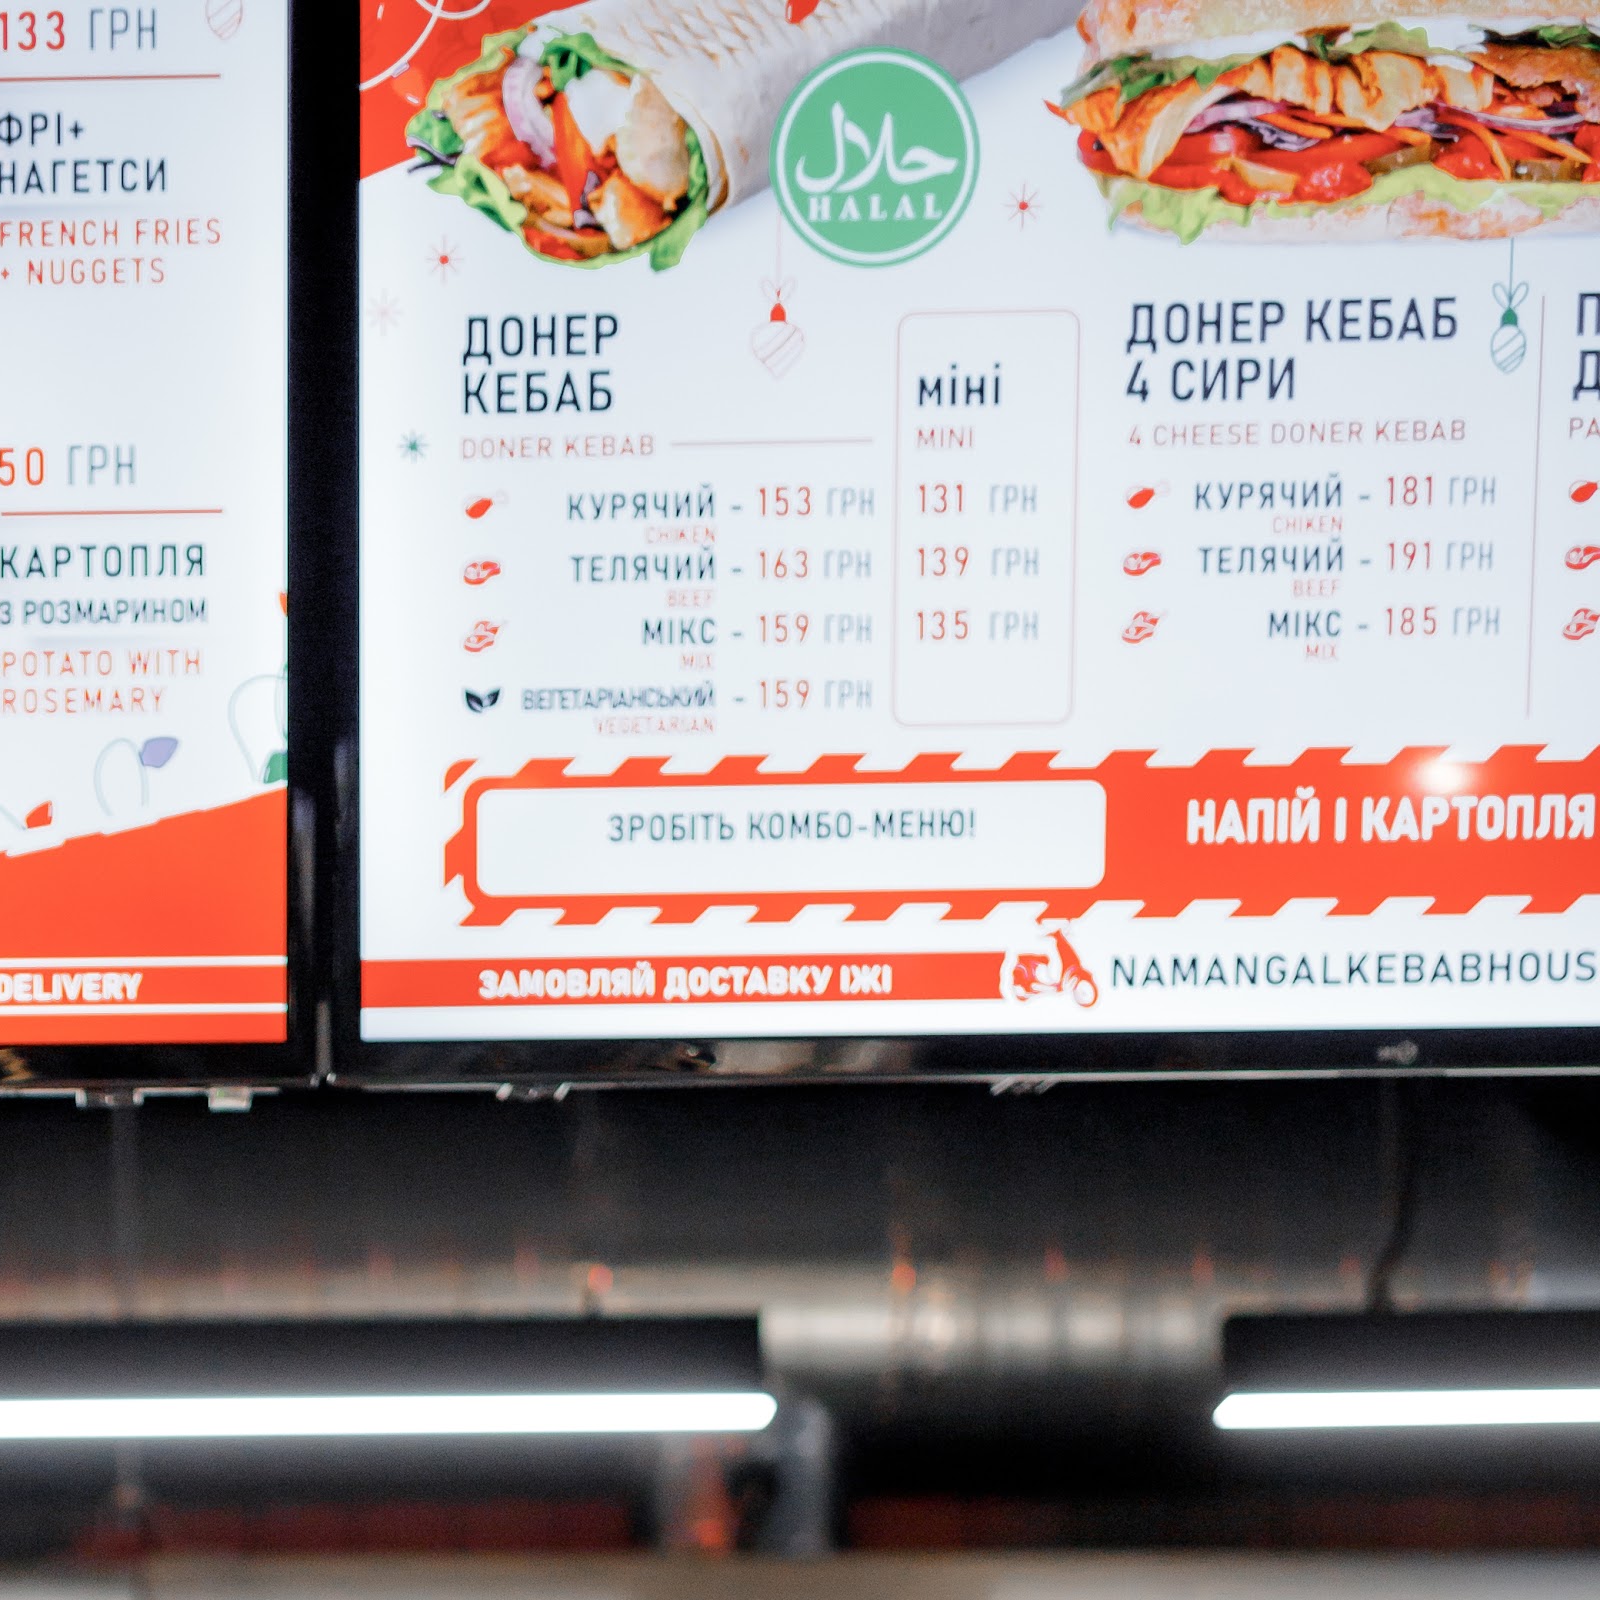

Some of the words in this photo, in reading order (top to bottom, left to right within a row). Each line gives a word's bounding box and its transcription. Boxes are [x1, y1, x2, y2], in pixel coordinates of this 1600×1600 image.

[88, 8, 157, 50] ГРН
[794, 102, 960, 194] حلال
[808, 193, 944, 222] HALAL
[0, 220, 119, 248] FRENCH
[134, 218, 223, 246] FRIES
[26, 257, 167, 286] NUGGETS
[462, 314, 619, 366] ДОНЕР
[1126, 302, 1286, 354] ДОНЕР
[1304, 298, 1458, 342] КЕБАБ
[462, 371, 614, 414] КЕБАБ
[1126, 360, 1149, 402] 4
[1171, 357, 1295, 400] СИРИ
[461, 439, 552, 462] DONER
[565, 435, 656, 457] KEBAB
[915, 427, 974, 450] MINI
[1127, 427, 1143, 447] 4
[1152, 425, 1259, 446] CHEESE
[1271, 422, 1363, 444] DONER
[1376, 419, 1467, 441] KEBAB
[68, 445, 138, 485] ГРН
[568, 484, 717, 521] КУРЯЧИЙ
[759, 486, 812, 517] 153
[827, 488, 875, 516] ГРН
[918, 484, 964, 514] 131
[989, 483, 1038, 513] ГРН
[1194, 472, 1343, 510] КУРЯЧИЙ
[1387, 475, 1434, 506] 181
[1450, 476, 1497, 506] ГРН
[1272, 515, 1343, 534] CHIKEN
[0, 544, 207, 579] КАРТОПЛЯ
[570, 544, 716, 583] ТЕЛЯЧИЙ
[759, 550, 809, 580] 163
[824, 550, 872, 579] ГРН
[917, 546, 970, 577] 139
[991, 547, 1040, 577] ГРН
[1197, 537, 1344, 573] ТЕЛЯЧИЙ
[1388, 542, 1432, 571] 191
[1445, 542, 1494, 571] ГРН
[23, 598, 208, 624] РОЗМАРИНОМ
[916, 610, 969, 641] 135
[989, 610, 1040, 640] ГРН
[1268, 610, 1342, 638] МІКС
[1385, 606, 1438, 636] 185
[1451, 606, 1502, 636] ГРН
[642, 617, 717, 646] МІКС
[759, 614, 810, 644] 159
[824, 614, 873, 643] ГРН
[2, 651, 113, 677] POTATO
[128, 649, 201, 675] WITH
[2, 688, 167, 714] ROSEMARY
[759, 680, 810, 710] 159
[824, 680, 874, 709] ГРН
[608, 813, 735, 842] ЗРОБІТЬ
[749, 809, 976, 840] КОМБО-МЕНЮ!
[1186, 786, 1320, 844] НАПІЙ
[1361, 794, 1596, 842] КАРТОПЛЯ
[479, 961, 655, 998] ЗАМОВЛЯЙ
[664, 965, 832, 1000] ДОСТАВКУ
[1111, 951, 1596, 988] NAMANGALKEBABHOUS
